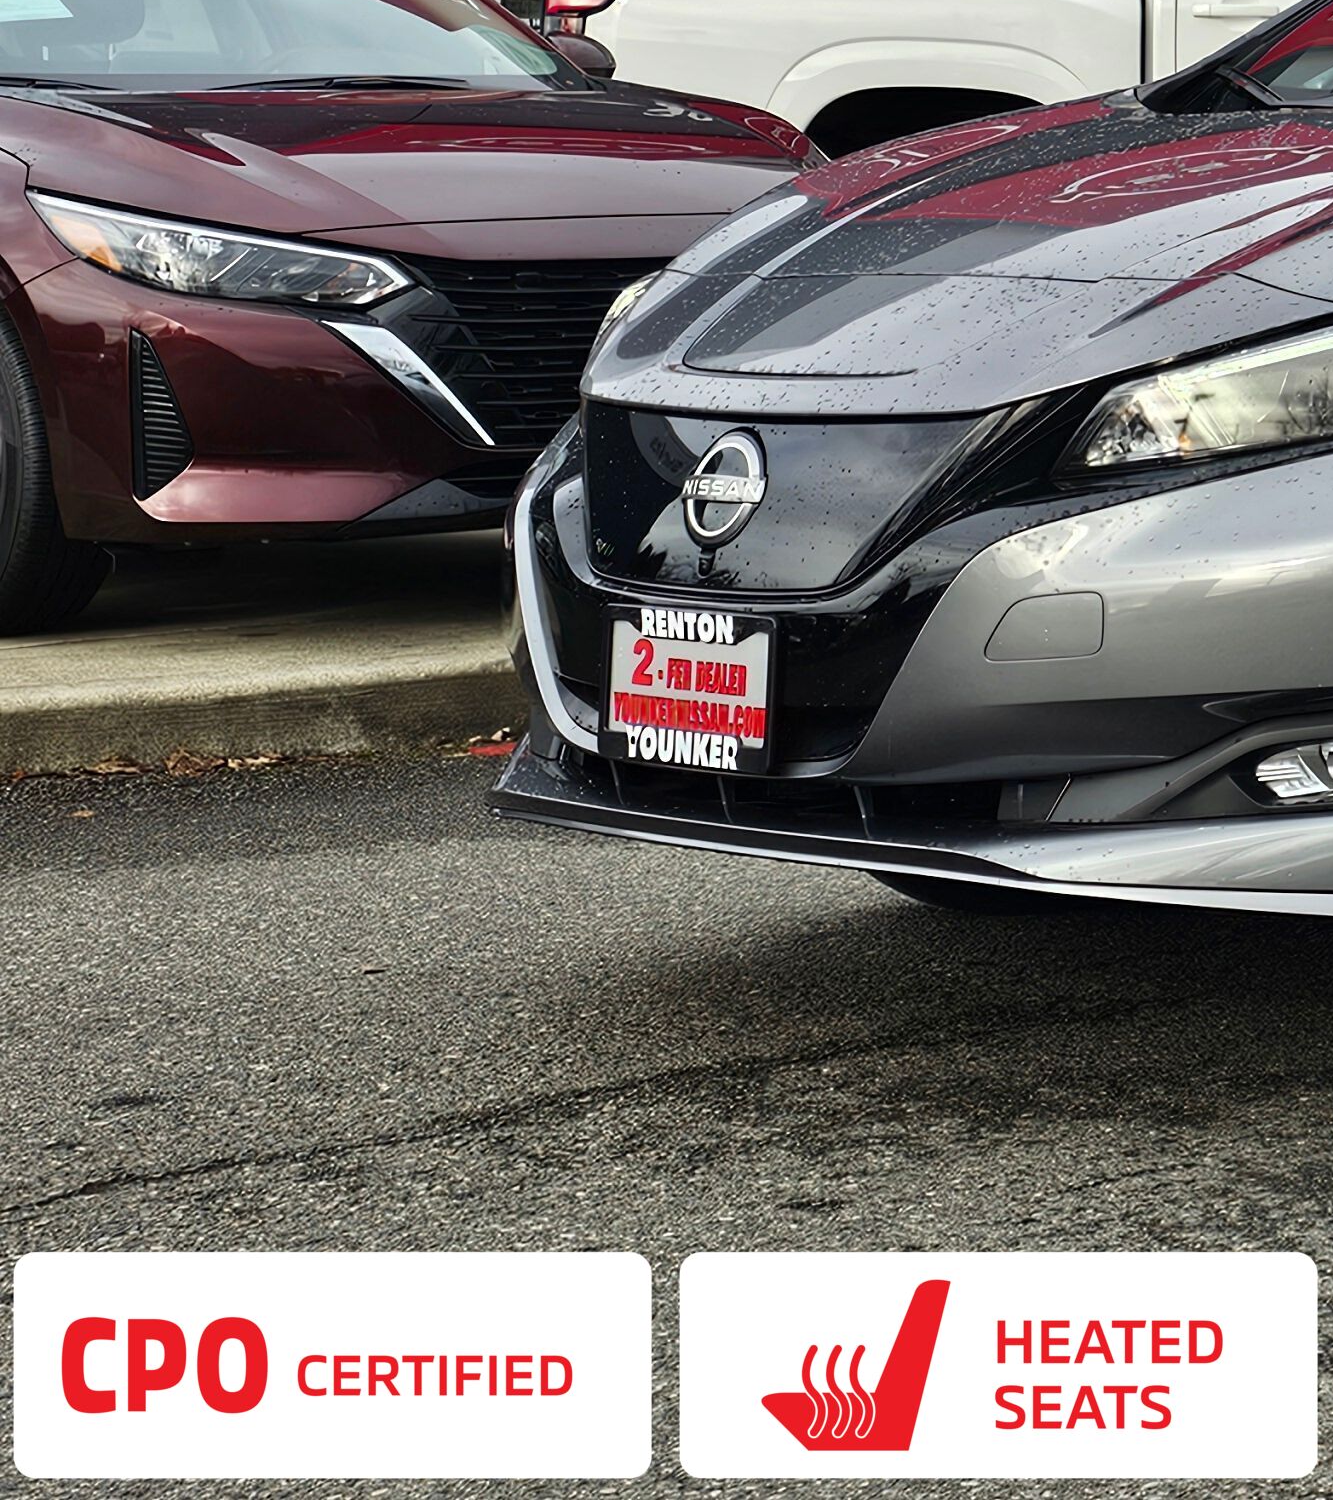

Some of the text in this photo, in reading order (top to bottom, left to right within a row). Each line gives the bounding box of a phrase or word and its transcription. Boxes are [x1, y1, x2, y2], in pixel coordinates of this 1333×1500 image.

[682, 479, 766, 502] NISSAN
[641, 608, 734, 644] RENTON
[632, 639, 654, 686] 2
[624, 725, 738, 770] YOUNKER
